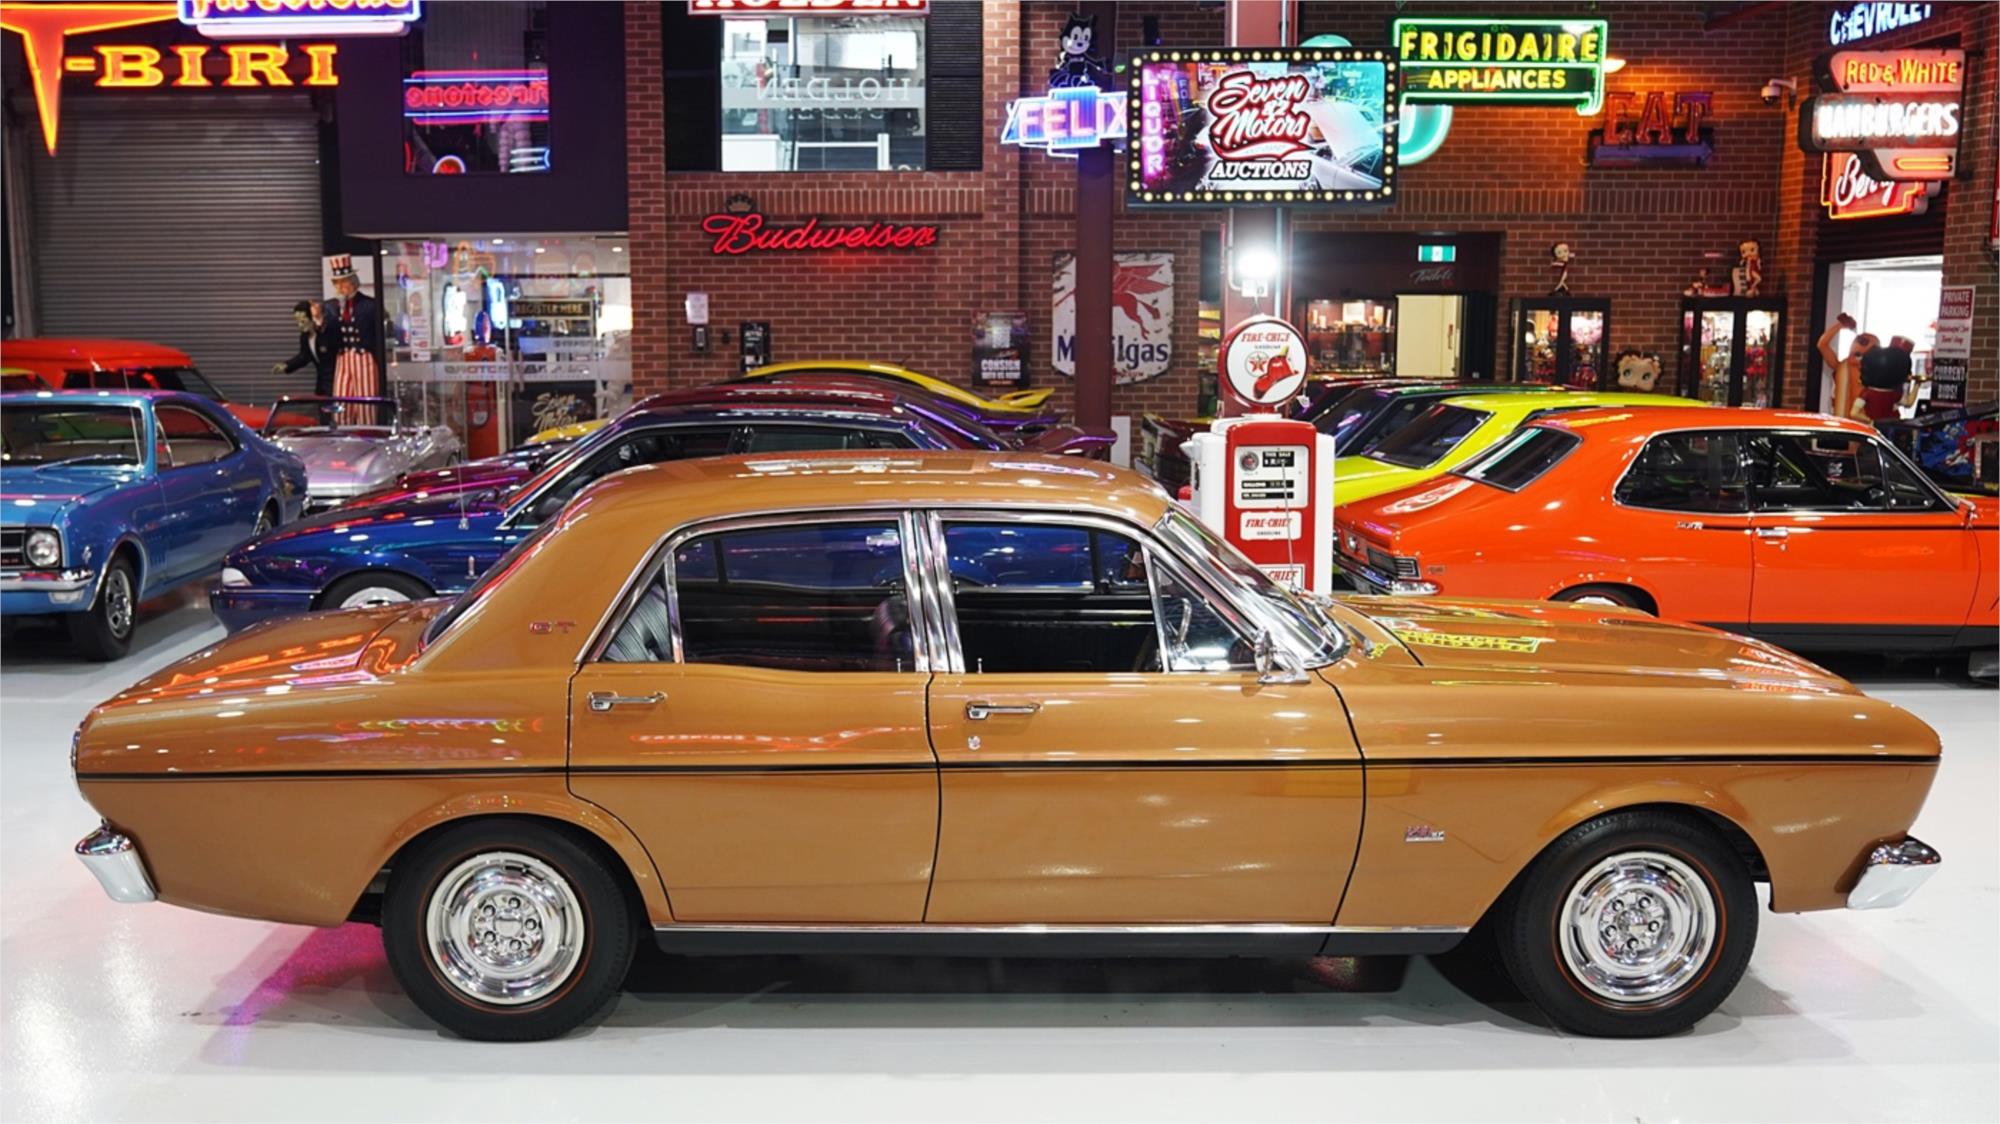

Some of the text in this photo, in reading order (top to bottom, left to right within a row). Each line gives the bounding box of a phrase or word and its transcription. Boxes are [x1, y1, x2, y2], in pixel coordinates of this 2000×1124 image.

[1401, 31, 1599, 61] FRIGIDAIRE
[1427, 70, 1566, 89] APPLIANCES
[1847, 60, 1880, 83] RED
[1900, 58, 1957, 84] WHITE
[1210, 75, 1305, 112] Seven
[1018, 98, 1127, 138] FELIX
[1142, 69, 1164, 176] LIQUOR
[1216, 109, 1307, 145] Motors
[1604, 91, 1713, 144] EAT
[1818, 103, 1959, 137] HAMBURGERS
[1210, 162, 1309, 179] AUCTIONS
[703, 213, 938, 254] Budweiser
[1940, 304, 1970, 318] PARKING
[1943, 290, 1970, 303] PRIVATE
